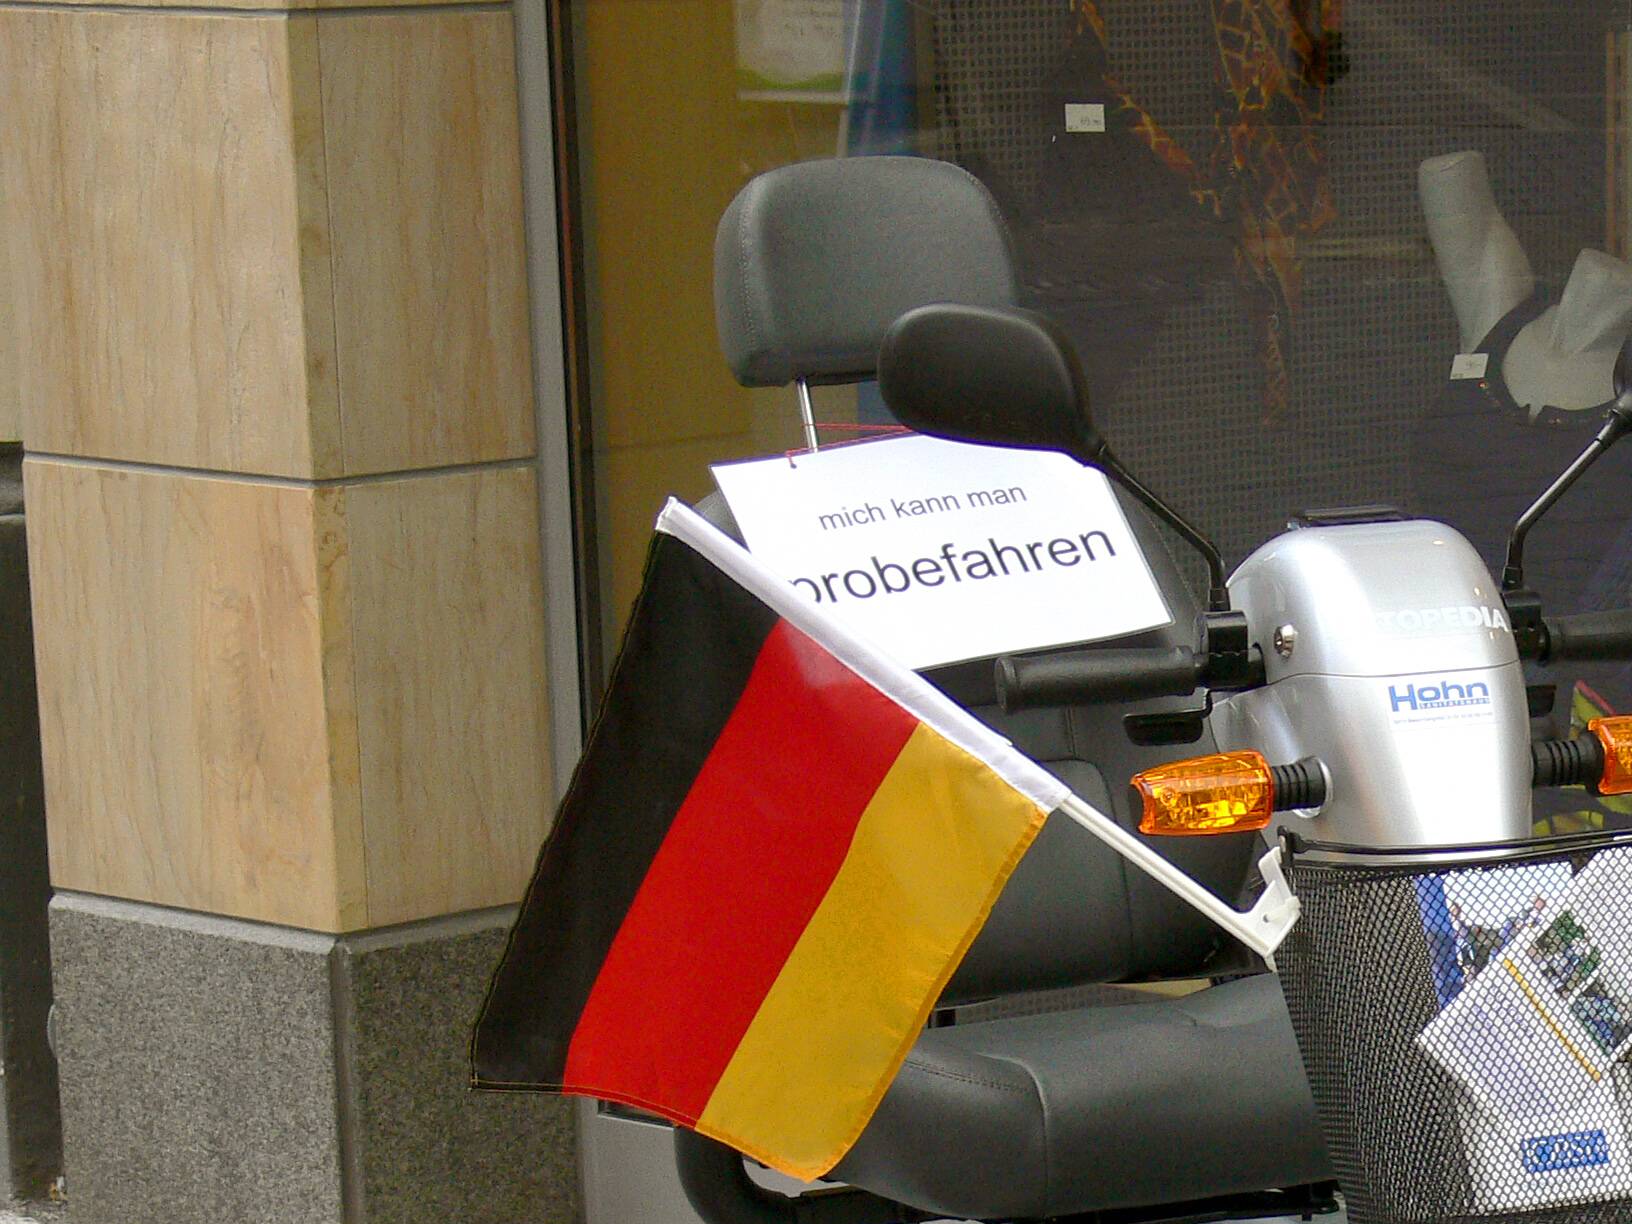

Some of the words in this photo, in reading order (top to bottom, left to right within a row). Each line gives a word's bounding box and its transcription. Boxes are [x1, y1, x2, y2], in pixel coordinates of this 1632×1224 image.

[818, 503, 886, 530] mich
[890, 492, 961, 520] kann
[967, 482, 1028, 505] man
[1387, 680, 1489, 713] Hohn
